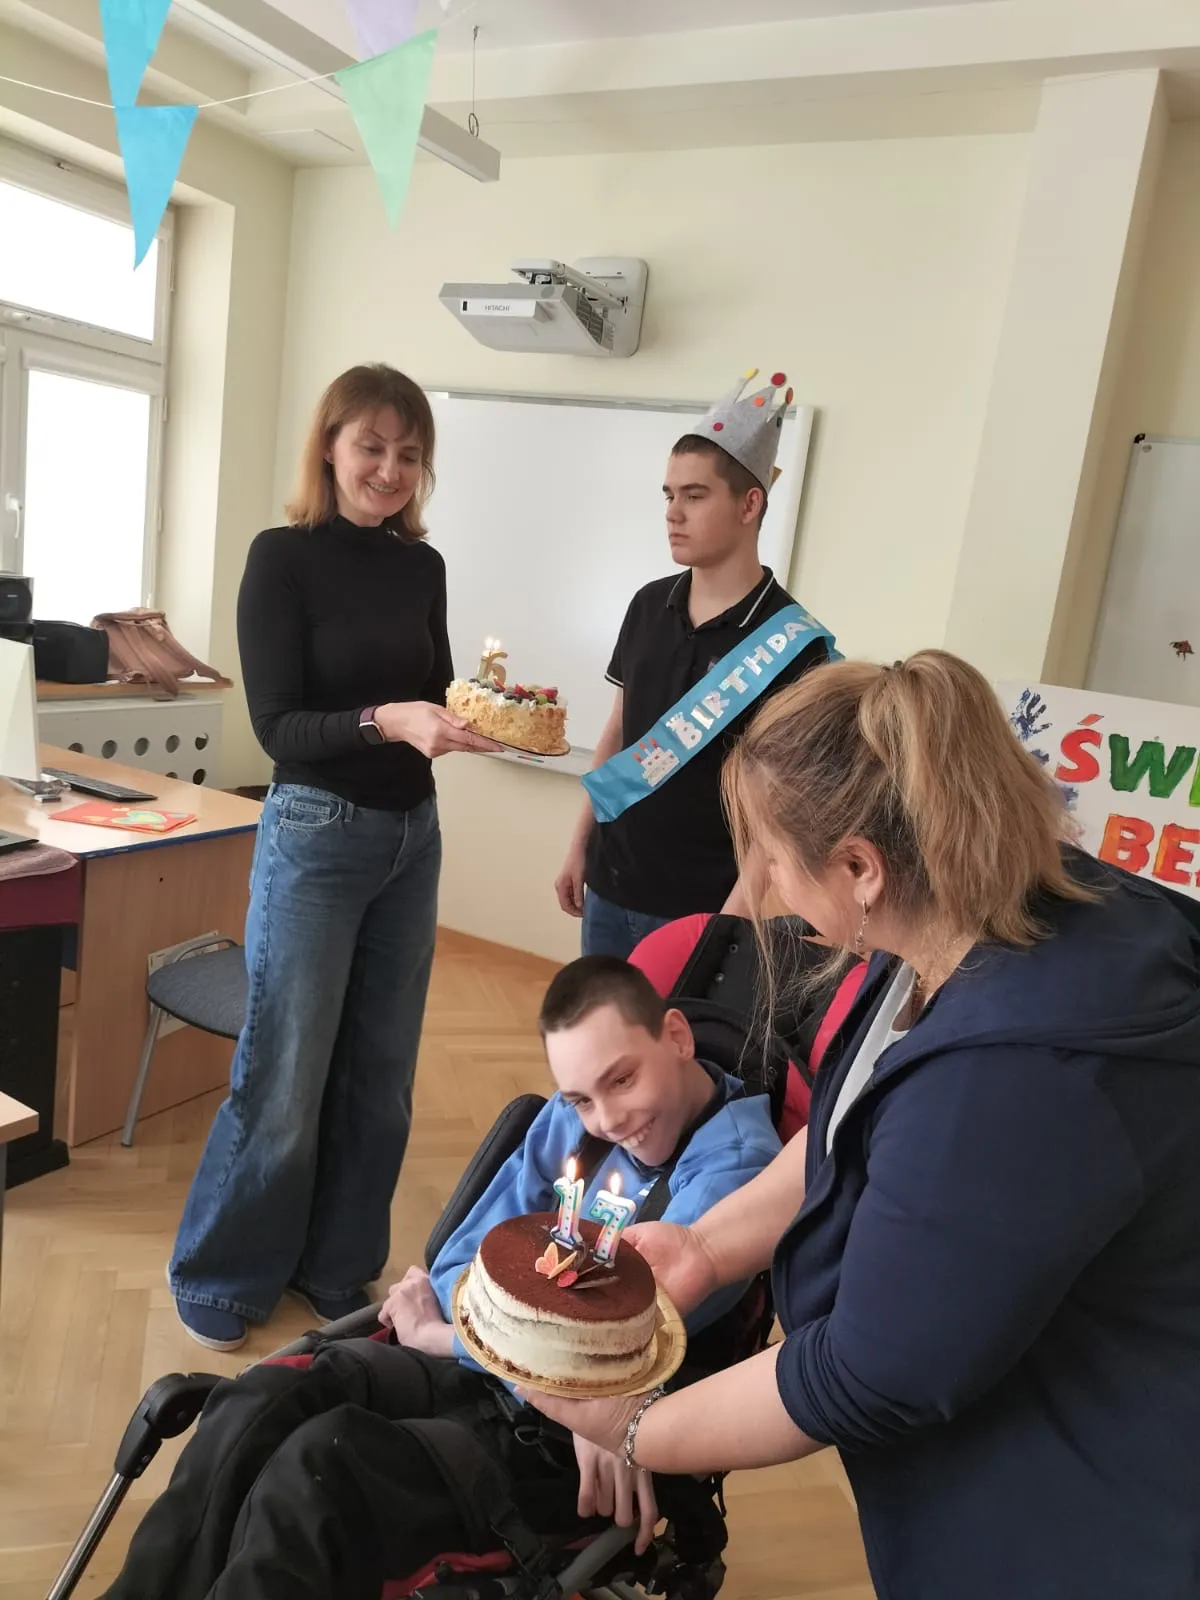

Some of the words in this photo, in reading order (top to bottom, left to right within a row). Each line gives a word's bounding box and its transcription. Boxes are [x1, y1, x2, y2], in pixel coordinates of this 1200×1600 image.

[484, 304, 510, 312] HITACHI
[1055, 713, 1200, 807] ŚW
[1099, 814, 1200, 888] BE
